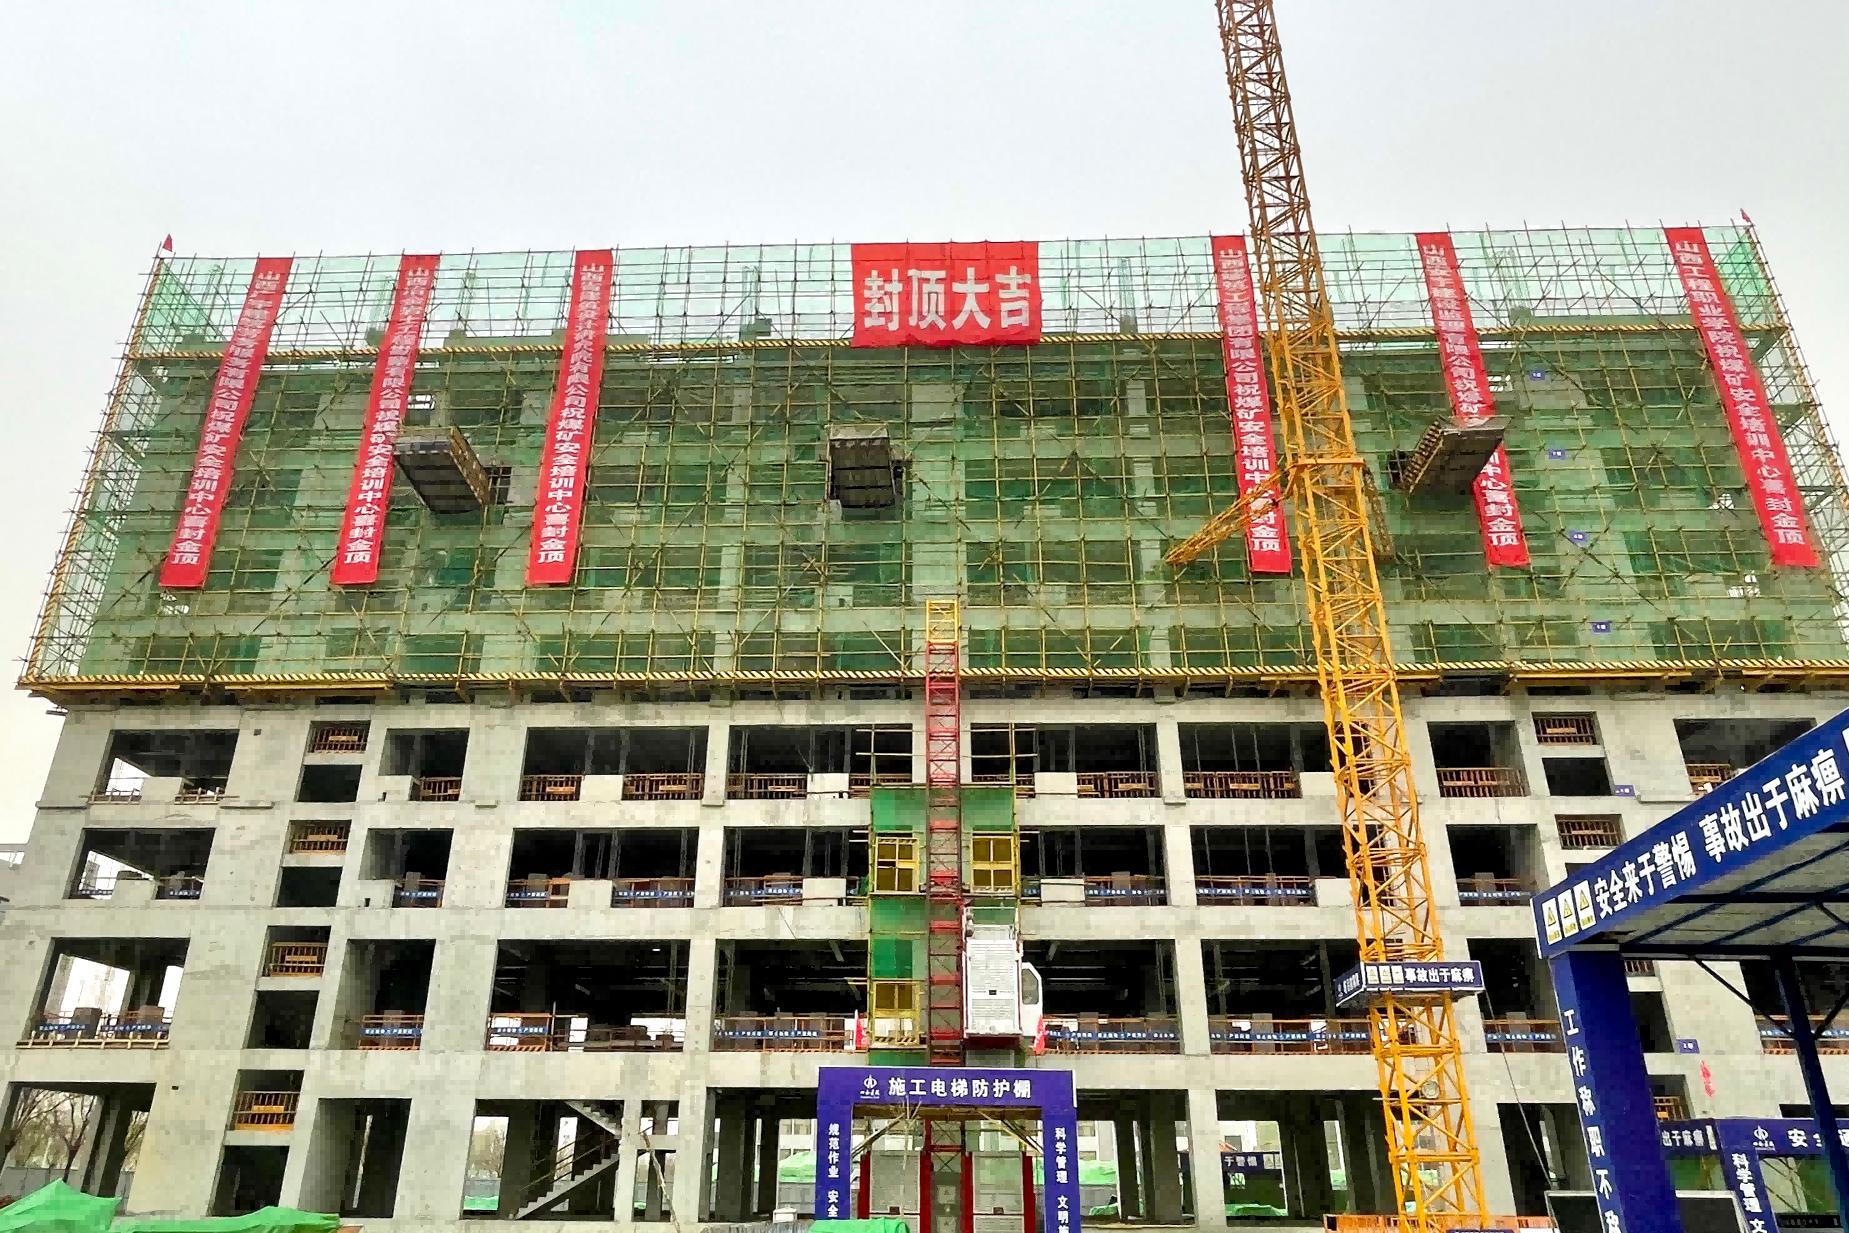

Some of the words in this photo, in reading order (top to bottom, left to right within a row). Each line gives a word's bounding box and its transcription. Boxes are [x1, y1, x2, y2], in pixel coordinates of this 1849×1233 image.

[864, 266, 1031, 331] 封顶大吉
[1594, 831, 1697, 919] 安全来于警惕
[1699, 748, 1846, 863] 事故出于麻痹
[1404, 967, 1475, 983] 事故出于麻痹
[888, 1078, 1031, 1098] 施工电梯防护棚
[828, 1123, 840, 1178] 规范作业
[1055, 1127, 1069, 1184] 科学管理
[827, 1190, 839, 1218] 安全
[1731, 1153, 1763, 1212] 科学管理
